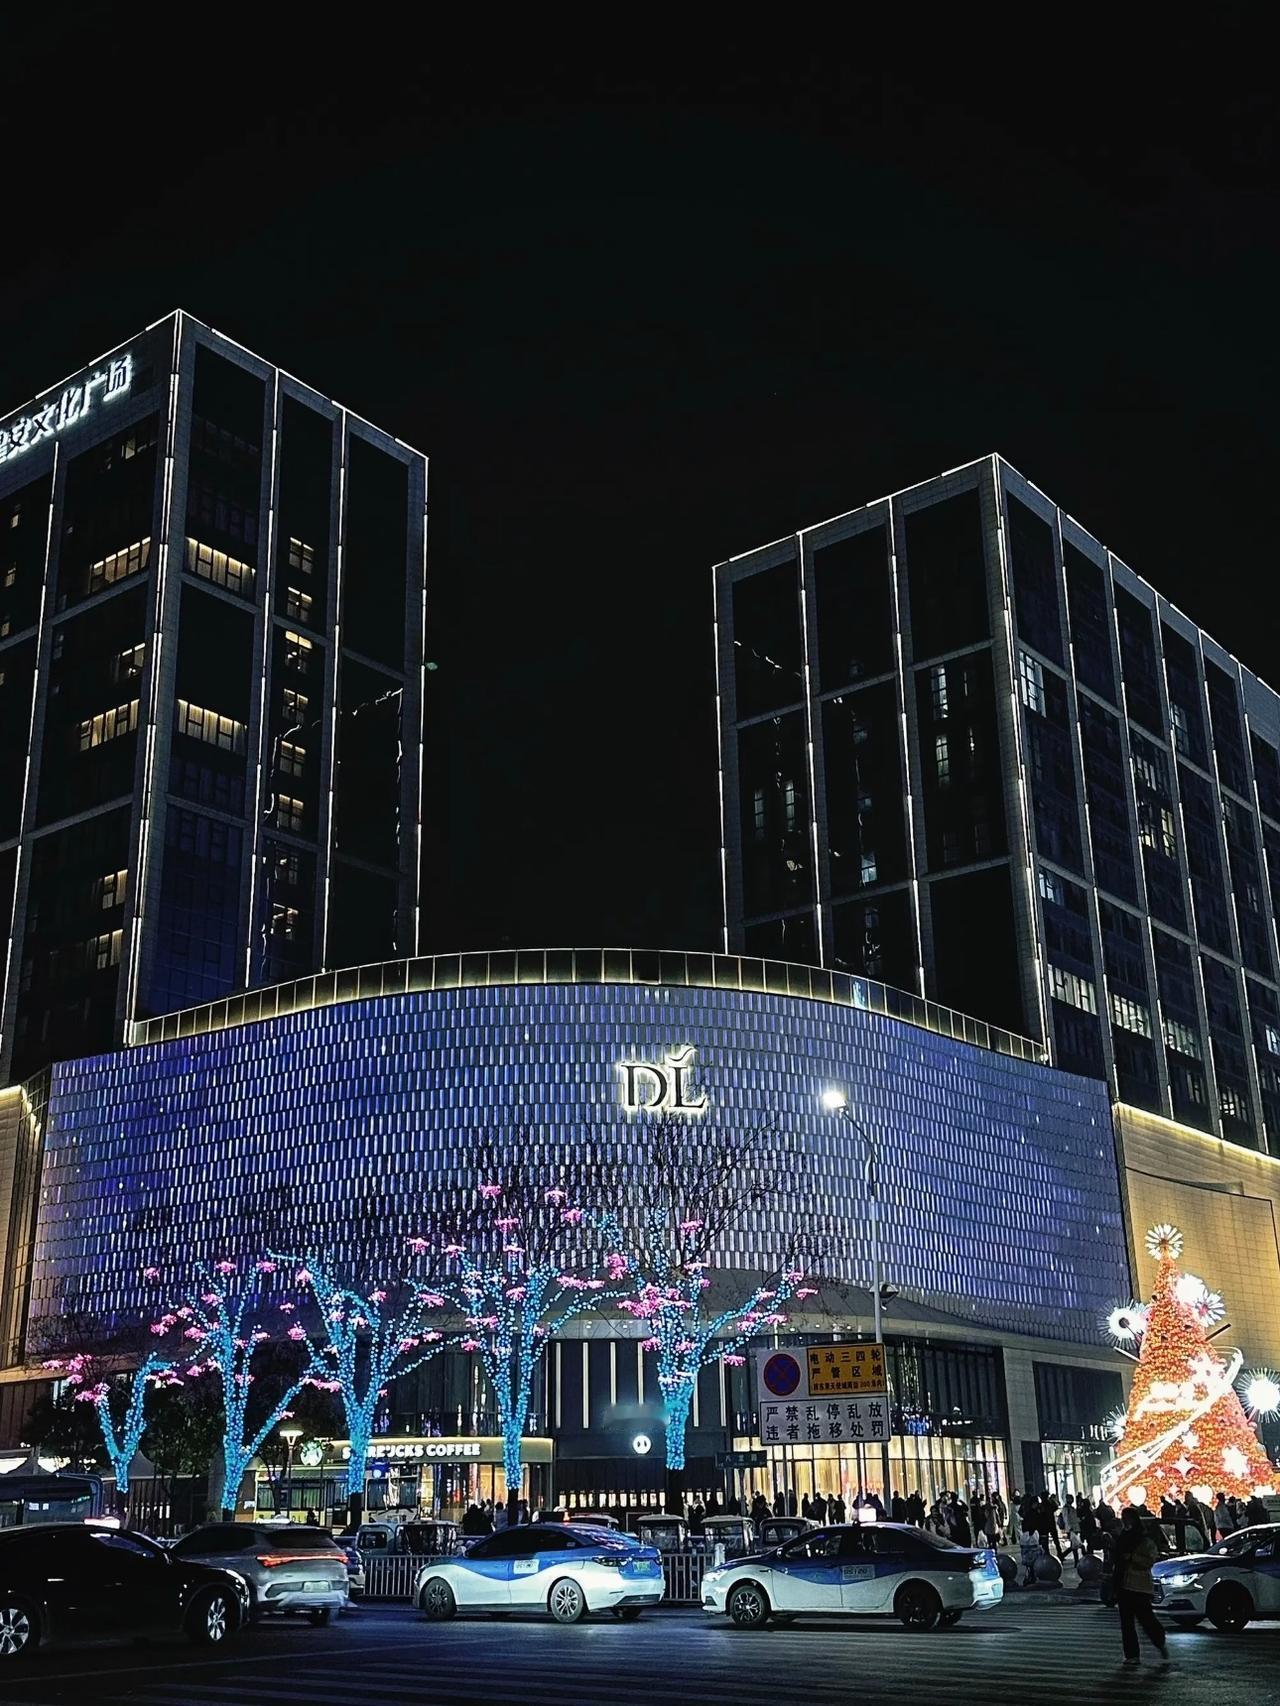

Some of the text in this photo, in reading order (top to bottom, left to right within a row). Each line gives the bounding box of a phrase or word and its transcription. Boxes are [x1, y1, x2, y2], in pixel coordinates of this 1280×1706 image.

[617, 1062, 708, 1110] DL
[810, 1349, 881, 1365] 电动三四轮
[811, 1364, 883, 1380] 严管区域
[766, 1402, 882, 1422] 严禁乱停乱放
[766, 1421, 884, 1441] 违者拖移处罚
[342, 1443, 481, 1460] SRBUCKS COFFEE
